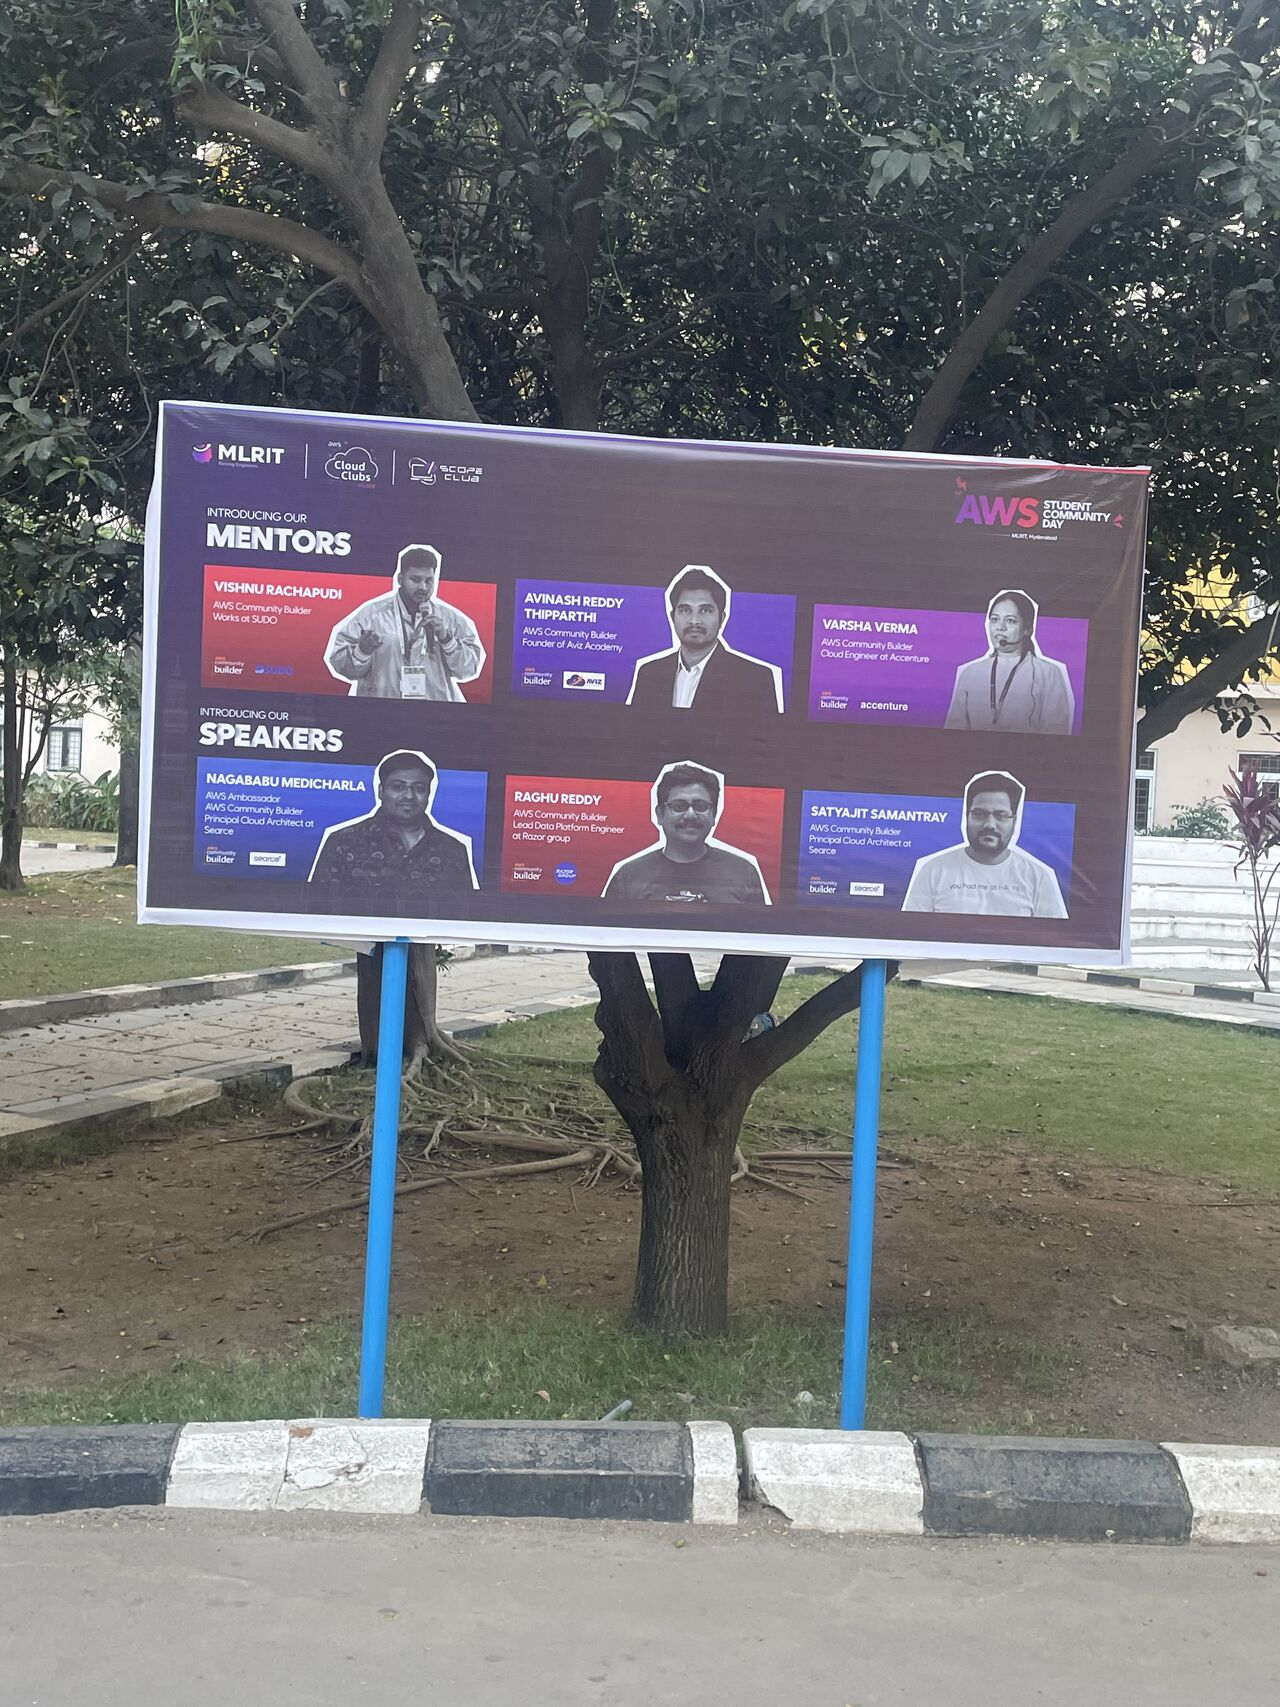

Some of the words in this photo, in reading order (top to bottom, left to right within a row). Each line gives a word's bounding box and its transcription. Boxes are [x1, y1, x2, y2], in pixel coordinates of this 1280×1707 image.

[217, 444, 284, 465] MLRIT
[334, 460, 366, 472] Cloud
[440, 465, 483, 475] SCOPE
[341, 470, 371, 482] Clubs
[444, 473, 480, 483] CLUB
[955, 494, 1039, 528] AWS
[1043, 500, 1092, 512] STUDENT
[207, 507, 282, 522] INTRODUCING
[283, 512, 307, 523] OUR
[1043, 509, 1111, 523] COMMUNITY
[1042, 519, 1064, 529] DAY
[206, 523, 352, 556] MENTORS
[214, 581, 264, 594] VISHNU
[266, 584, 342, 600] RACHAPUDI
[524, 593, 581, 606] AVINASH
[583, 596, 624, 608] REDDY
[213, 601, 234, 610] AWS
[235, 602, 282, 615] Community
[284, 606, 312, 615] Builder
[213, 612, 240, 622] Works
[241, 615, 250, 623] at
[251, 615, 277, 624] SUDO
[524, 608, 597, 623] THIPPARTHI
[823, 619, 872, 632] VARSHA
[874, 621, 918, 634] VERMA
[523, 627, 543, 636] AWS
[544, 628, 589, 640] Community
[591, 631, 617, 640] Builder
[522, 638, 555, 648] Founder
[556, 640, 566, 648] of
[567, 641, 583, 650] Aviz
[584, 642, 623, 653] Academy
[821, 638, 841, 647] AWS
[842, 639, 886, 651] Community
[887, 642, 913, 651] Builder
[821, 649, 844, 658] Cloud
[845, 651, 878, 661] Engineer
[880, 653, 888, 661] at
[890, 653, 929, 663] Accenture
[214, 665, 243, 674] builder
[524, 676, 551, 686] builder
[820, 700, 847, 709] builder
[861, 701, 908, 711] accenture
[200, 708, 266, 720] INTRODUCING
[268, 711, 289, 721] OUR
[199, 722, 343, 752] SPEAKERS
[206, 773, 279, 787] NAGABABU
[281, 777, 366, 792] MEDICHARLA
[205, 792, 226, 801] AWS
[228, 793, 280, 803] Ambassador
[514, 791, 559, 803] RAGHU
[561, 794, 601, 805] REDDY
[205, 804, 226, 812] AWS
[227, 805, 274, 816] Community
[276, 807, 303, 816] Builder
[513, 809, 533, 818] AWS
[535, 810, 580, 822] Community
[581, 813, 607, 822] Builder
[811, 806, 868, 819] SATYAJIT
[870, 809, 948, 822] SAMANTRAY
[205, 815, 239, 826] Principal
[240, 816, 265, 825] Cloud
[266, 818, 303, 828] Architect
[305, 820, 314, 828] at
[513, 821, 533, 829] Lead
[535, 822, 554, 830] Data
[555, 823, 589, 832] Platform
[591, 825, 624, 834] Engineer
[204, 826, 234, 835] Searce
[810, 824, 829, 833] AWS
[830, 825, 874, 836] Community
[875, 827, 901, 836] Builder
[523, 833, 545, 841] Razor
[547, 835, 571, 843] group
[809, 835, 841, 845] Principal
[843, 837, 865, 845] Cloud
[866, 838, 901, 847] Architect
[903, 840, 911, 848] at
[808, 846, 836, 855] Searce
[206, 855, 234, 864] builder
[514, 872, 541, 880] builder
[810, 885, 836, 893] builder
